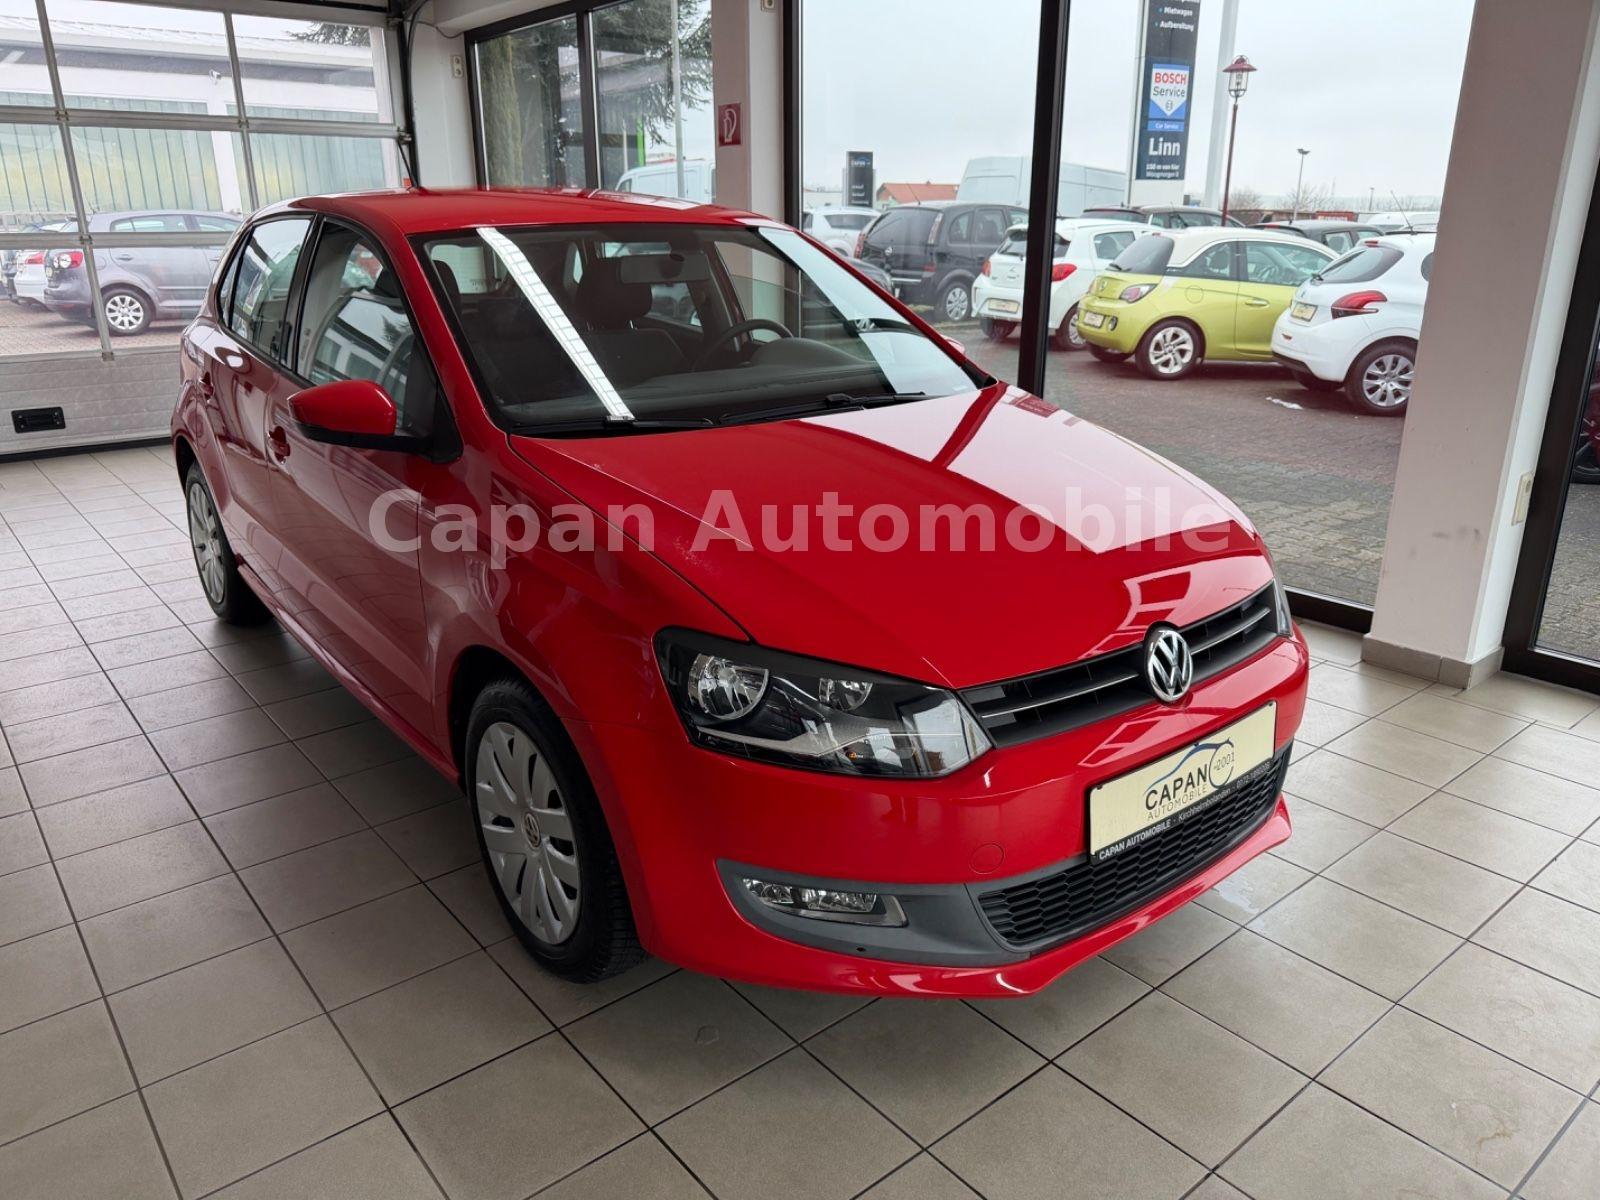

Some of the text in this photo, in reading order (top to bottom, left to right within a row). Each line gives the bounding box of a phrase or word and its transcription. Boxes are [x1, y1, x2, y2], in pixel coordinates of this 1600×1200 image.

[1153, 86, 1186, 97] Service
[1154, 72, 1187, 85] BOSCH
[1148, 136, 1181, 156] Linn
[1145, 763, 1208, 811] CAPAN
[1147, 783, 1208, 820] AUTOMOBILE
[1099, 841, 1125, 860] CAPAN
[1126, 819, 1171, 849] AUTOMOBILE
